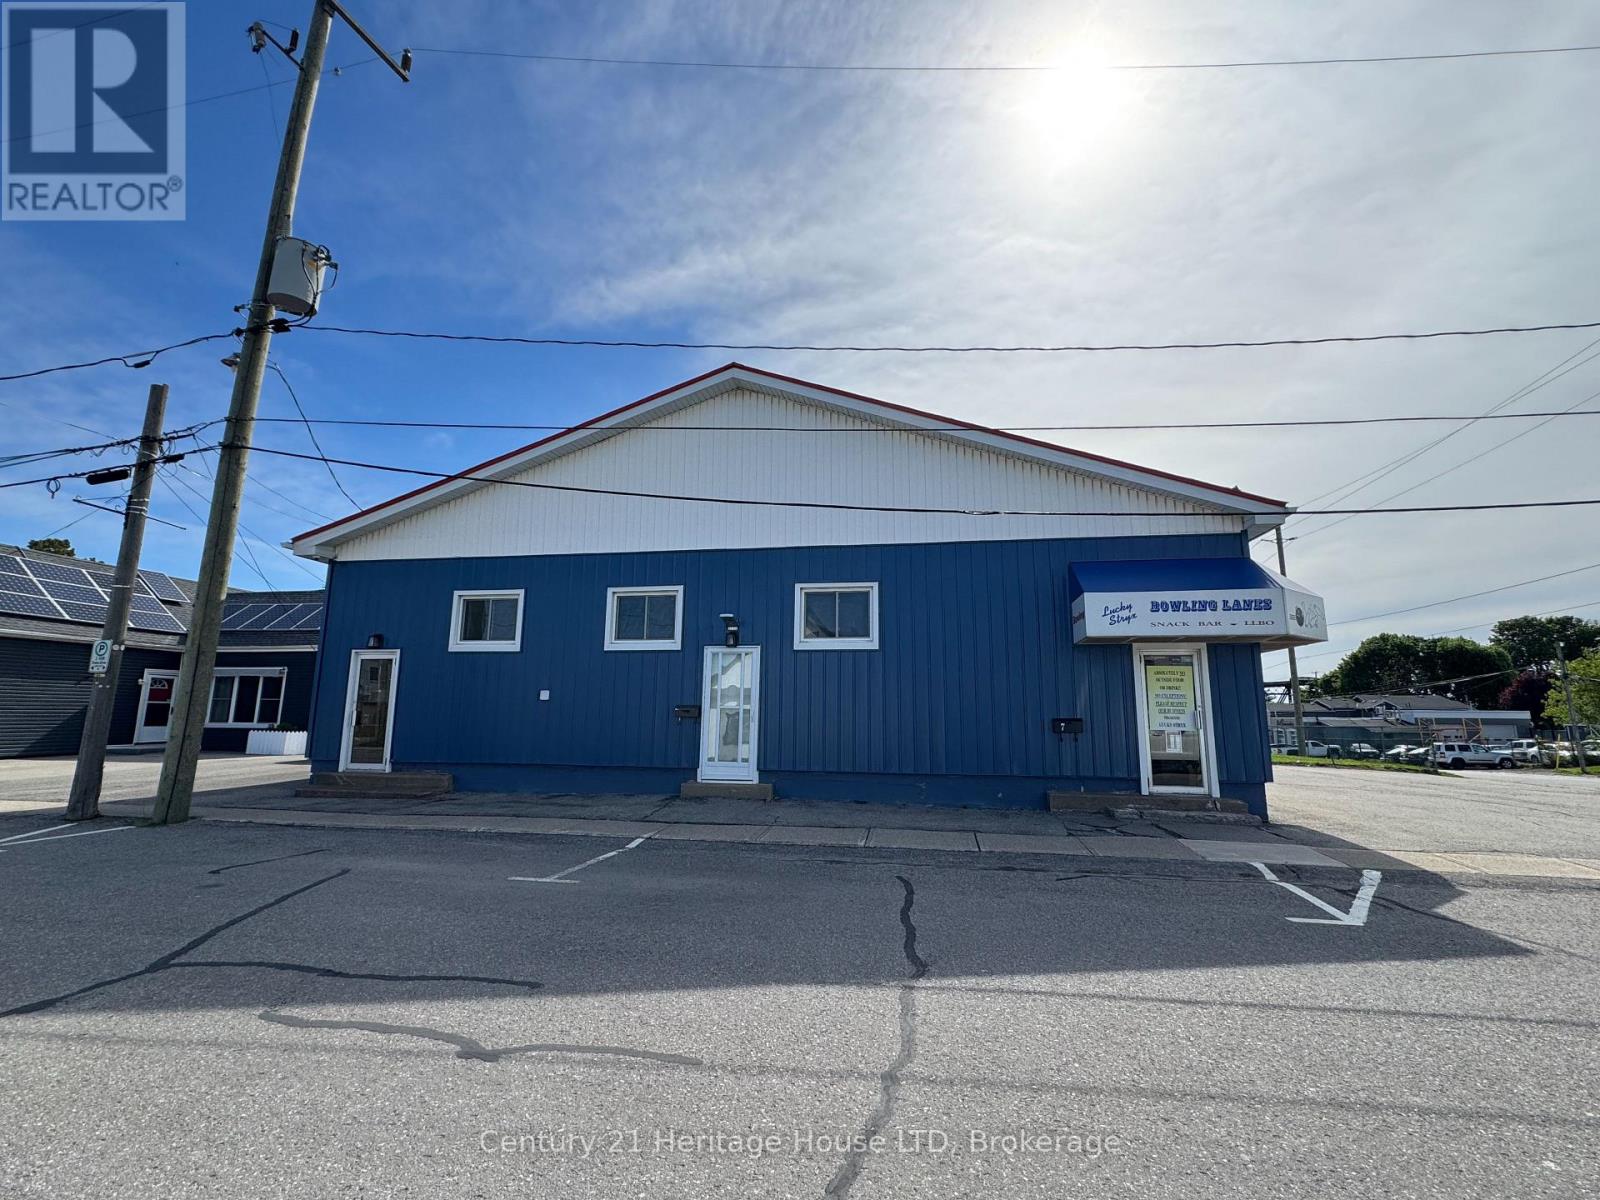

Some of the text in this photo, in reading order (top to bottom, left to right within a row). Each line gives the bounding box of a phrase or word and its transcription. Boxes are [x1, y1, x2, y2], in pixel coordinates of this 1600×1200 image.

[1101, 601, 1133, 618] Lucky
[1150, 598, 1273, 613] BOWLING LANES
[1108, 612, 1138, 626] Stryx
[1060, 722, 1066, 731] 7
